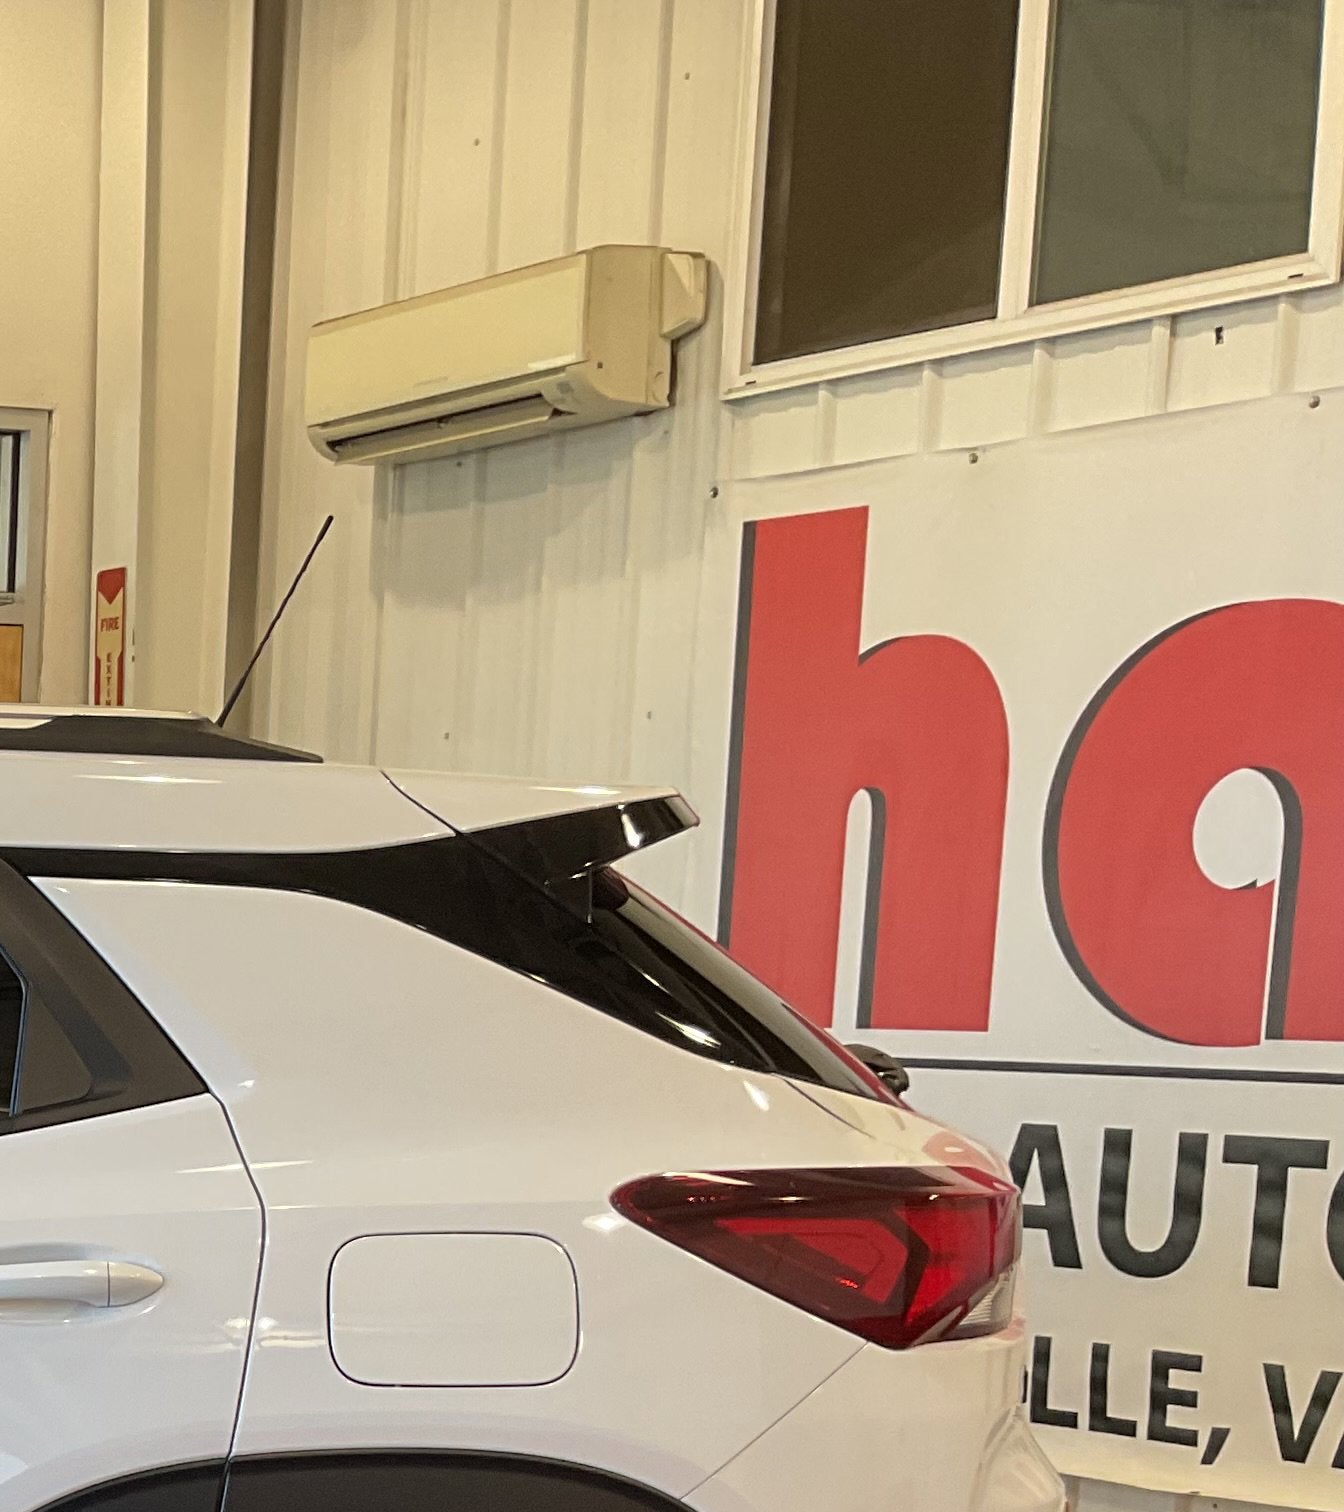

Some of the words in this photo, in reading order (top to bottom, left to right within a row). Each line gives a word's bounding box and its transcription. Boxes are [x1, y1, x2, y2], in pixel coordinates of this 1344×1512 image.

[100, 616, 120, 632] FIRE
[1008, 1122, 1344, 1289] AUT
[1021, 1334, 1231, 1466] LLE,
[1262, 1362, 1344, 1470] V
